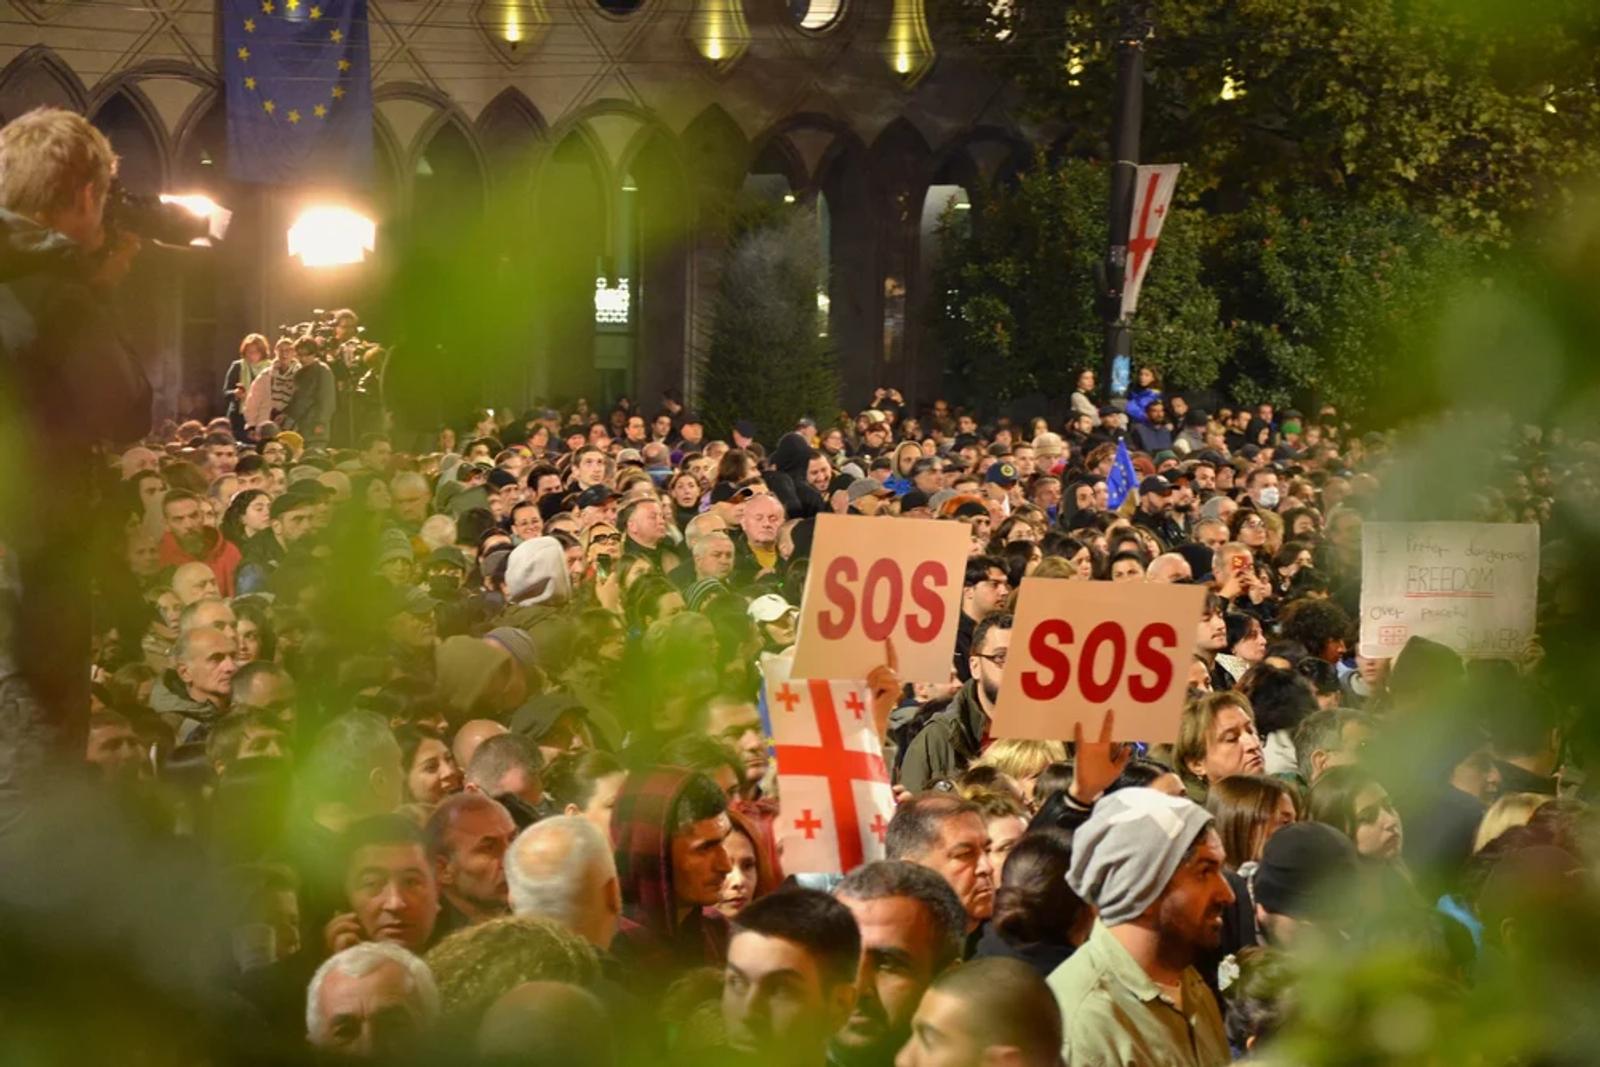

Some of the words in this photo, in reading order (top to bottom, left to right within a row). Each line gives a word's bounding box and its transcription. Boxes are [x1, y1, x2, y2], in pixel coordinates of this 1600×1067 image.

[817, 556, 948, 643] SOS
[1406, 565, 1494, 591] FREEDOM
[1020, 618, 1177, 703] SOS
